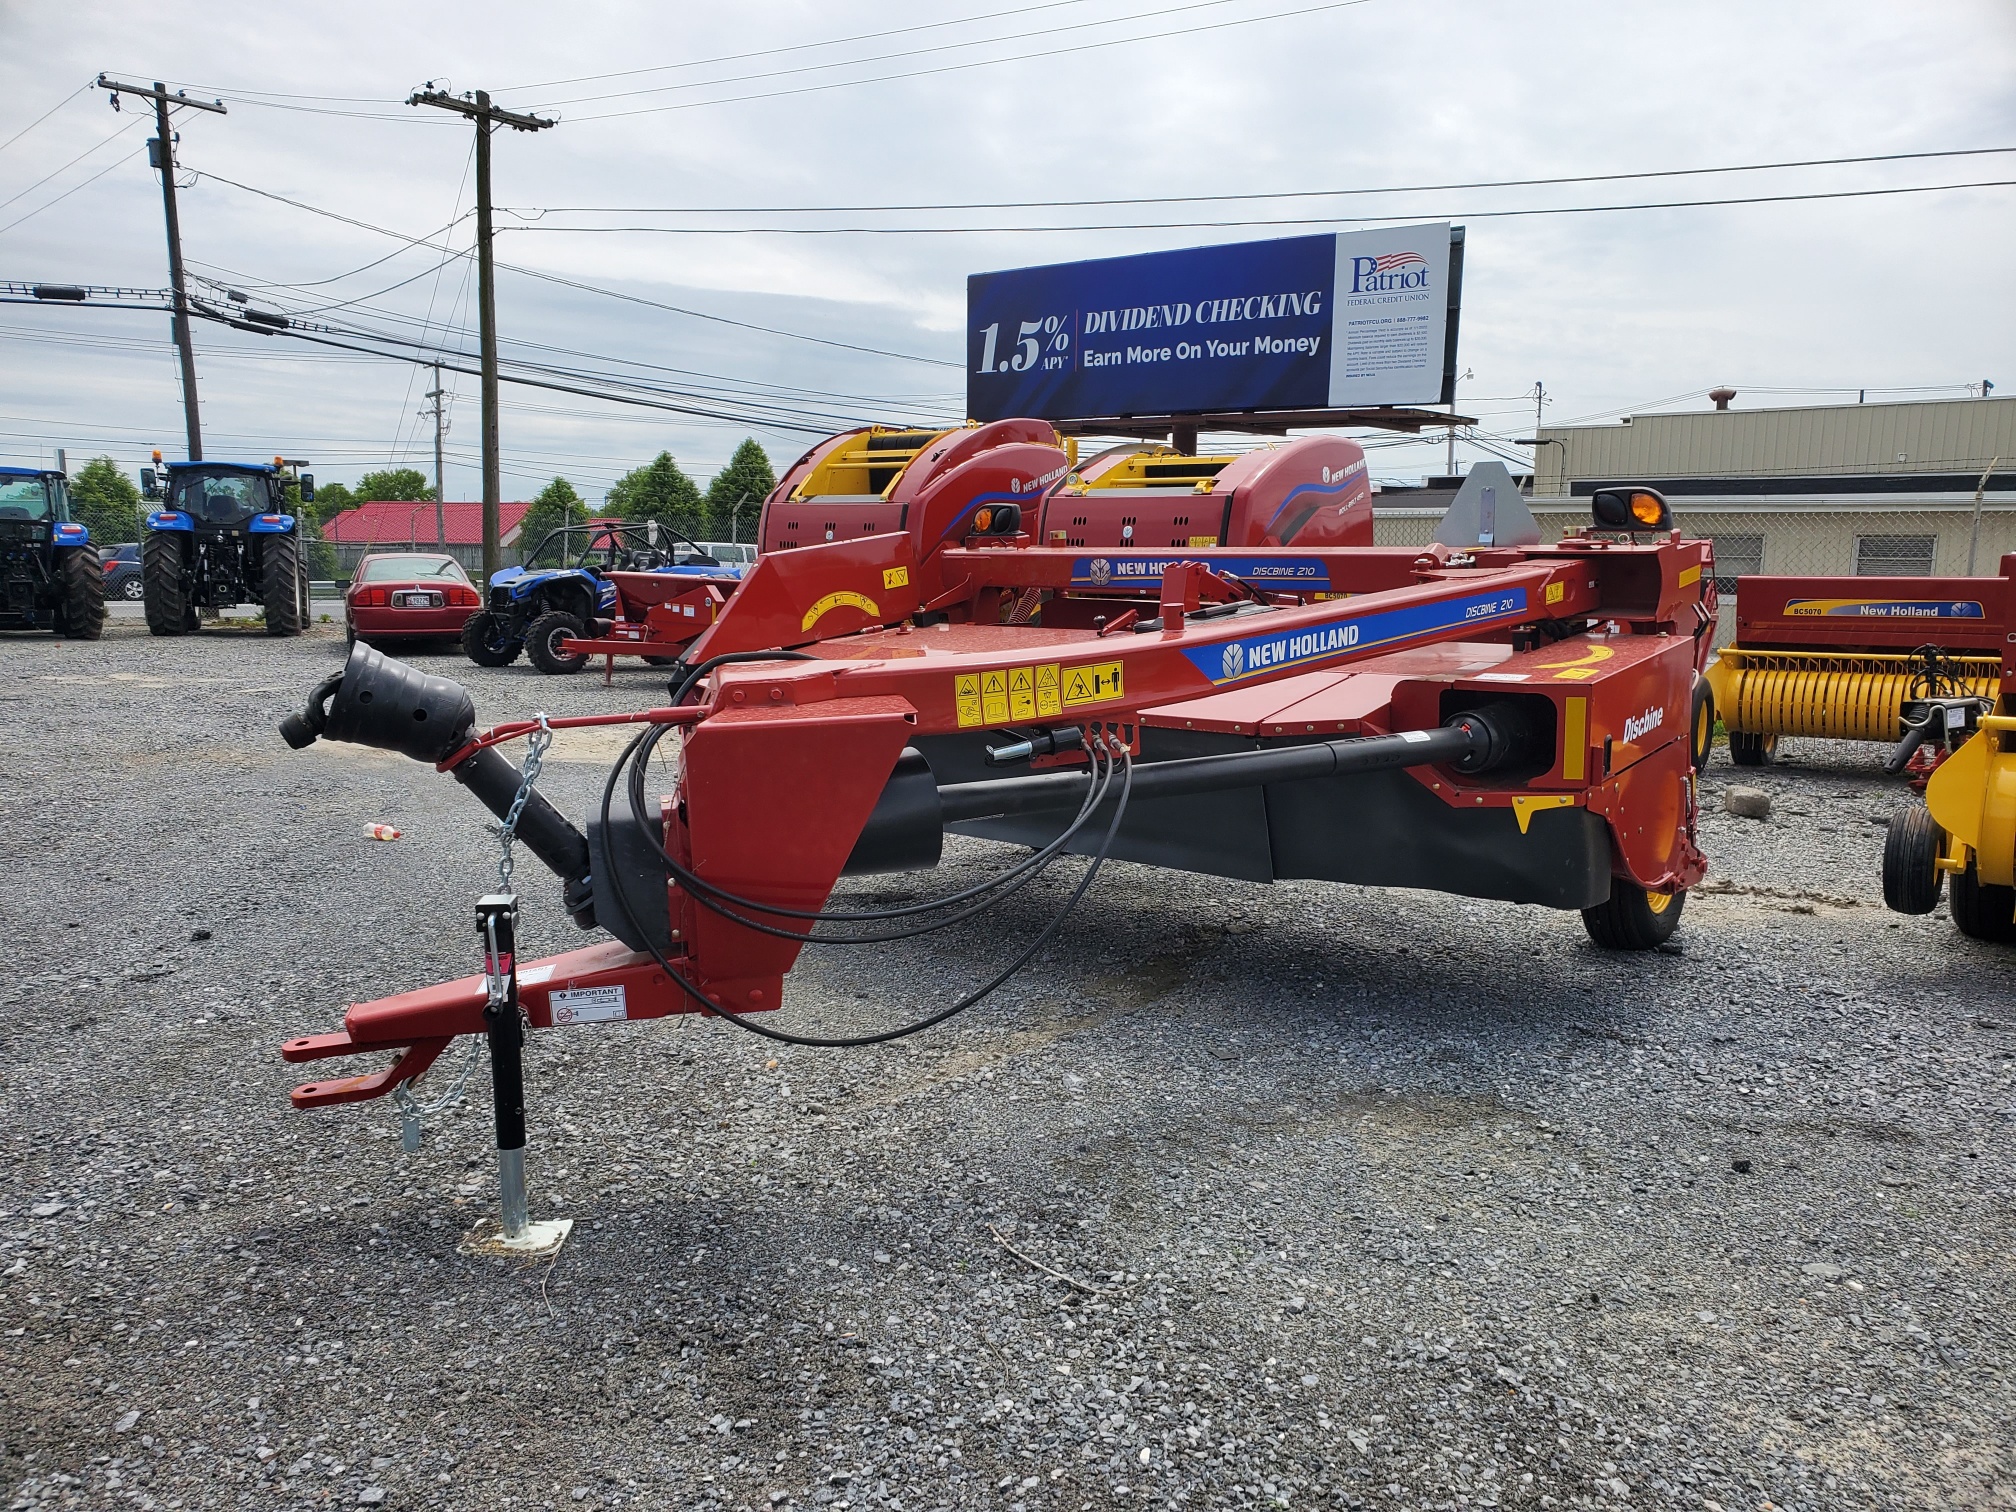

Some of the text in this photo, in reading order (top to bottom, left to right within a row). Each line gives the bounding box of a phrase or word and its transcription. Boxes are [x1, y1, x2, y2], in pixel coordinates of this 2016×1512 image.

[1348, 256, 1430, 293] Patriot
[1347, 298, 1376, 306] FEDERAL
[1377, 295, 1404, 304] CREDIT
[1084, 290, 1322, 334] DIVIDEND CHECKING
[975, 314, 1069, 374] 1.5%
[1083, 335, 1321, 368] Earn More On Your Money
[1023, 464, 1069, 494] NEW HOLLAND
[1331, 468, 1344, 484] NEW
[1117, 562, 1147, 576] NEW
[1251, 566, 1316, 576] DISCBINE 210
[1465, 597, 1514, 619] DISCBINE 210
[1793, 608, 1822, 616] BC5070
[1860, 605, 1939, 617] New Holland
[1249, 624, 1360, 669] NEW HOLLAND
[1622, 705, 1664, 745] Discbine
[570, 988, 618, 997] IMPORTANT
